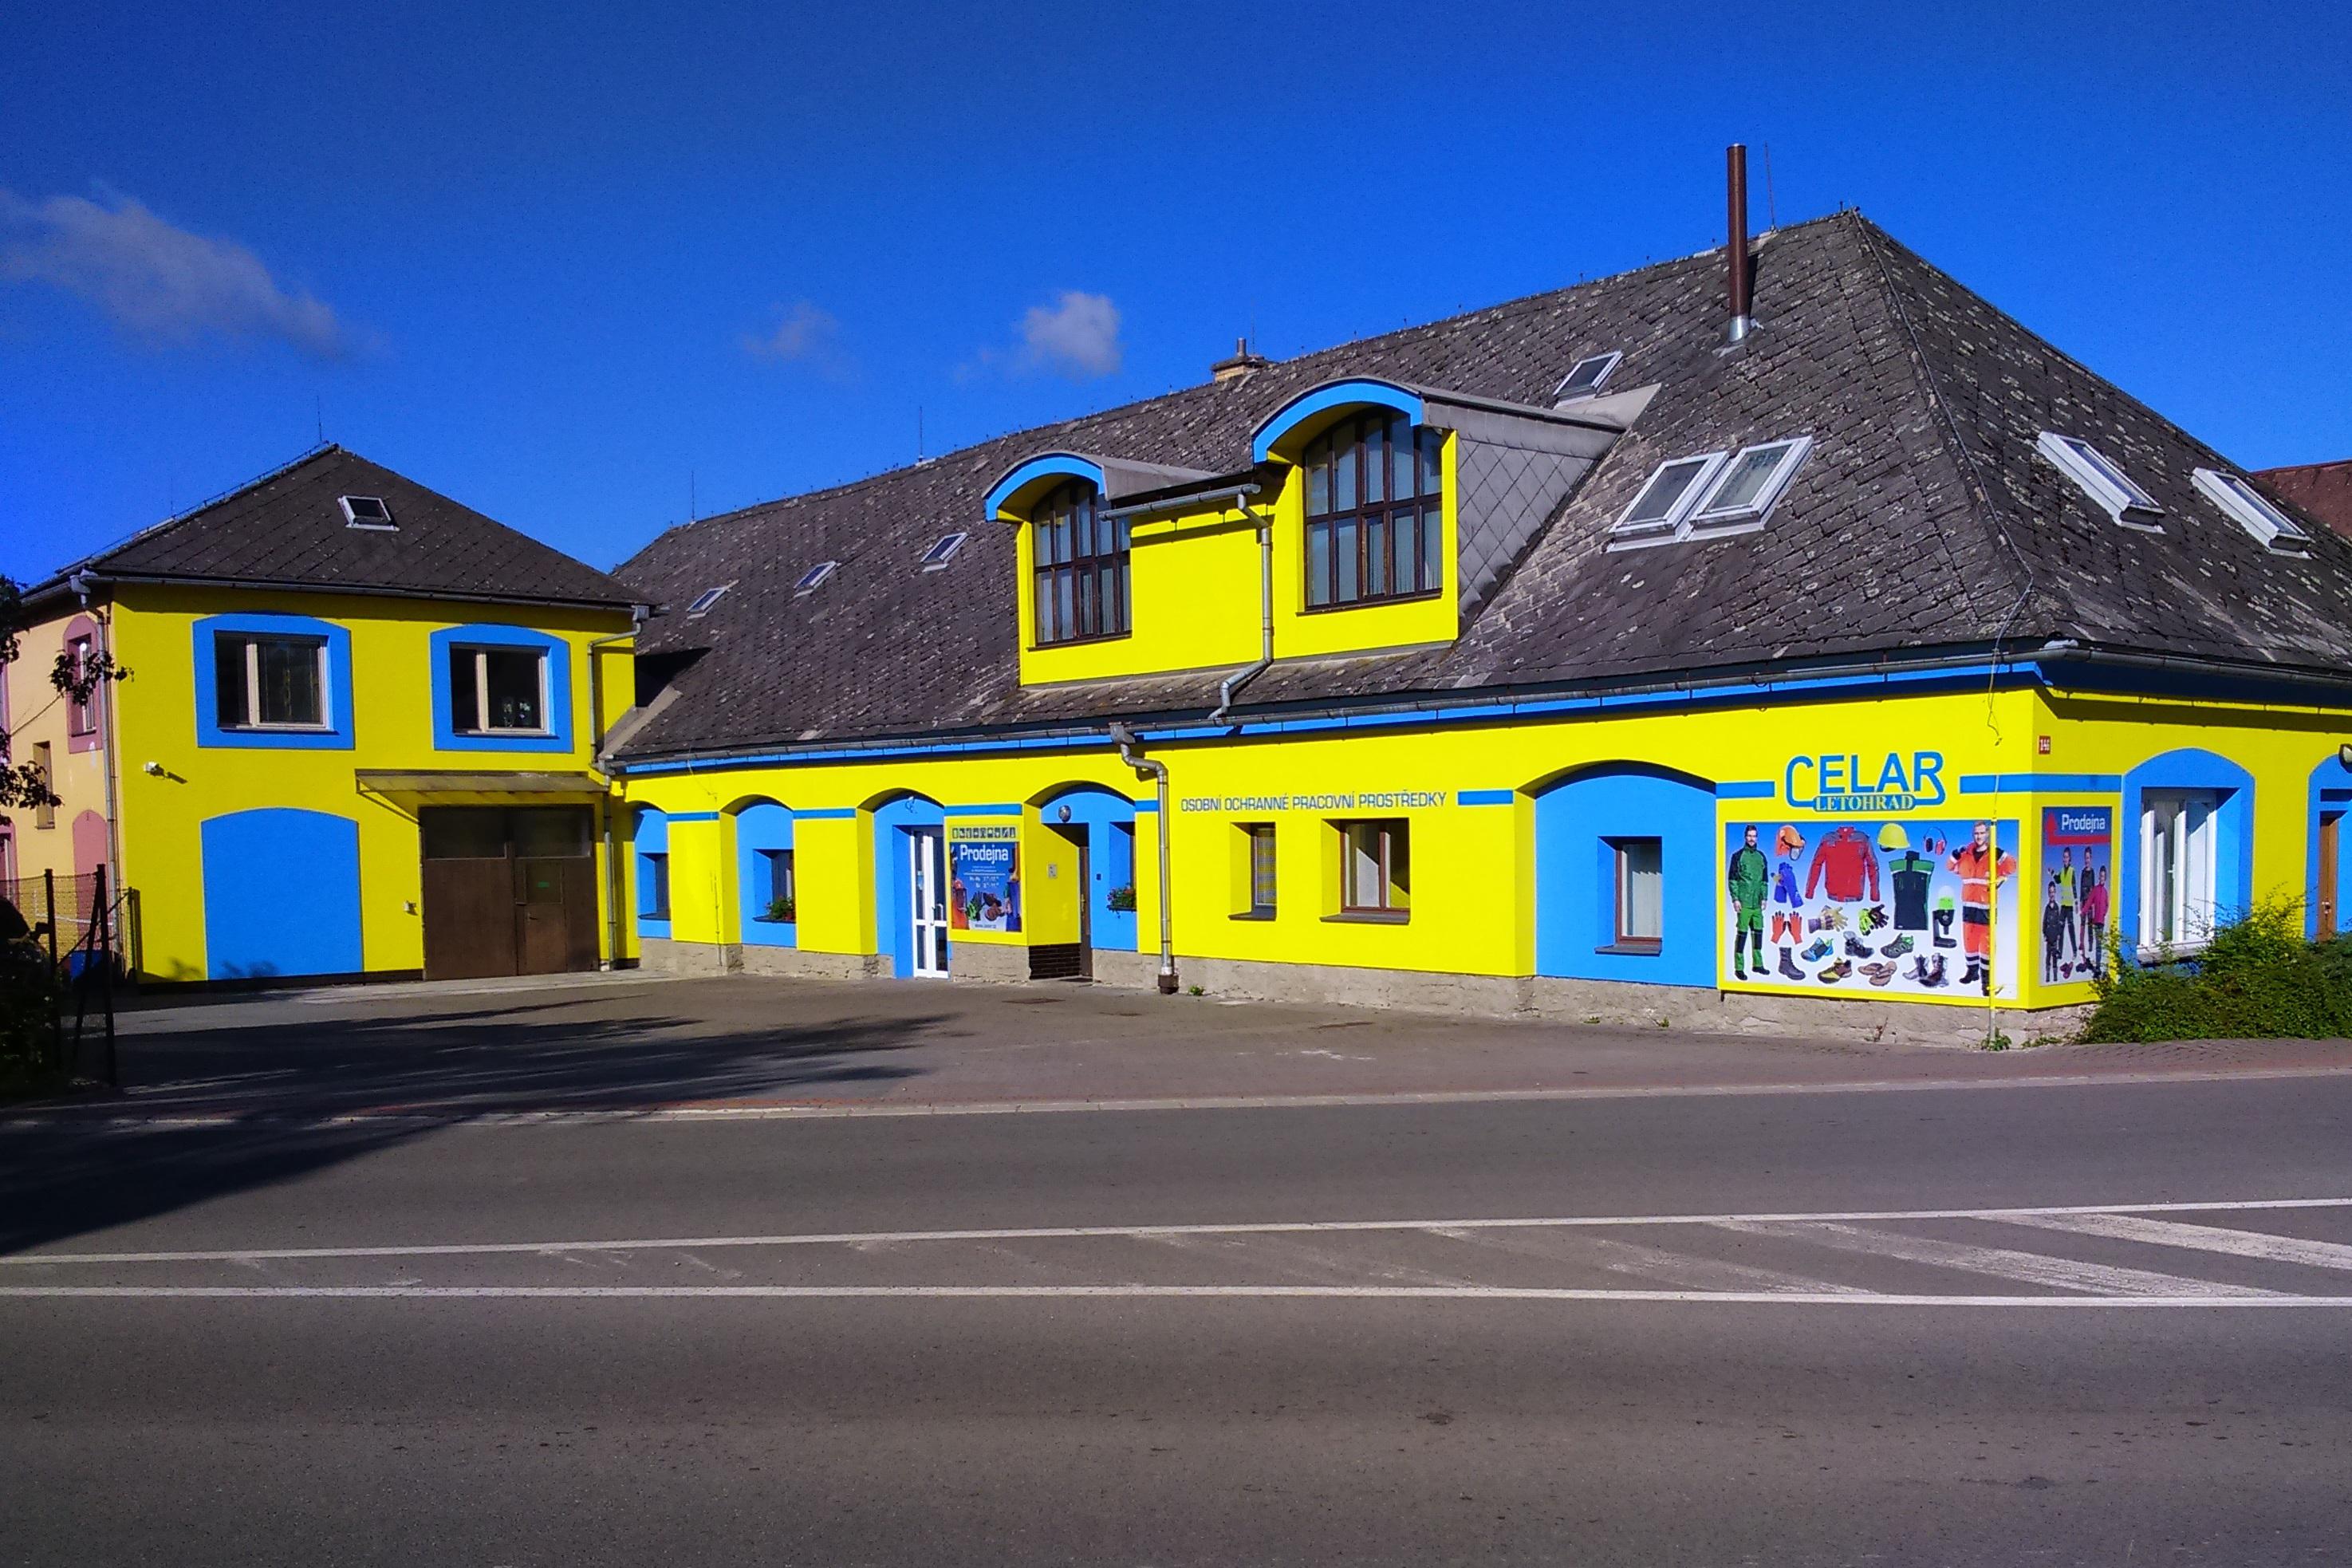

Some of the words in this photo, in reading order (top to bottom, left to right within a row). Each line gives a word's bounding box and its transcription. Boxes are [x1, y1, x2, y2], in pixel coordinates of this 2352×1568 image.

[1786, 751, 1946, 807] CELAR
[1180, 794, 1222, 812] OSOBNÍ
[1224, 793, 1289, 811] OCHRANNÉ
[1292, 791, 1355, 810] PRACOVNÍ
[1358, 790, 1448, 809] PROSTŘEDKY
[1815, 795, 1914, 811] LETOHRAD
[2061, 814, 2106, 833] Prodejna
[959, 844, 1009, 865] Prodejna
